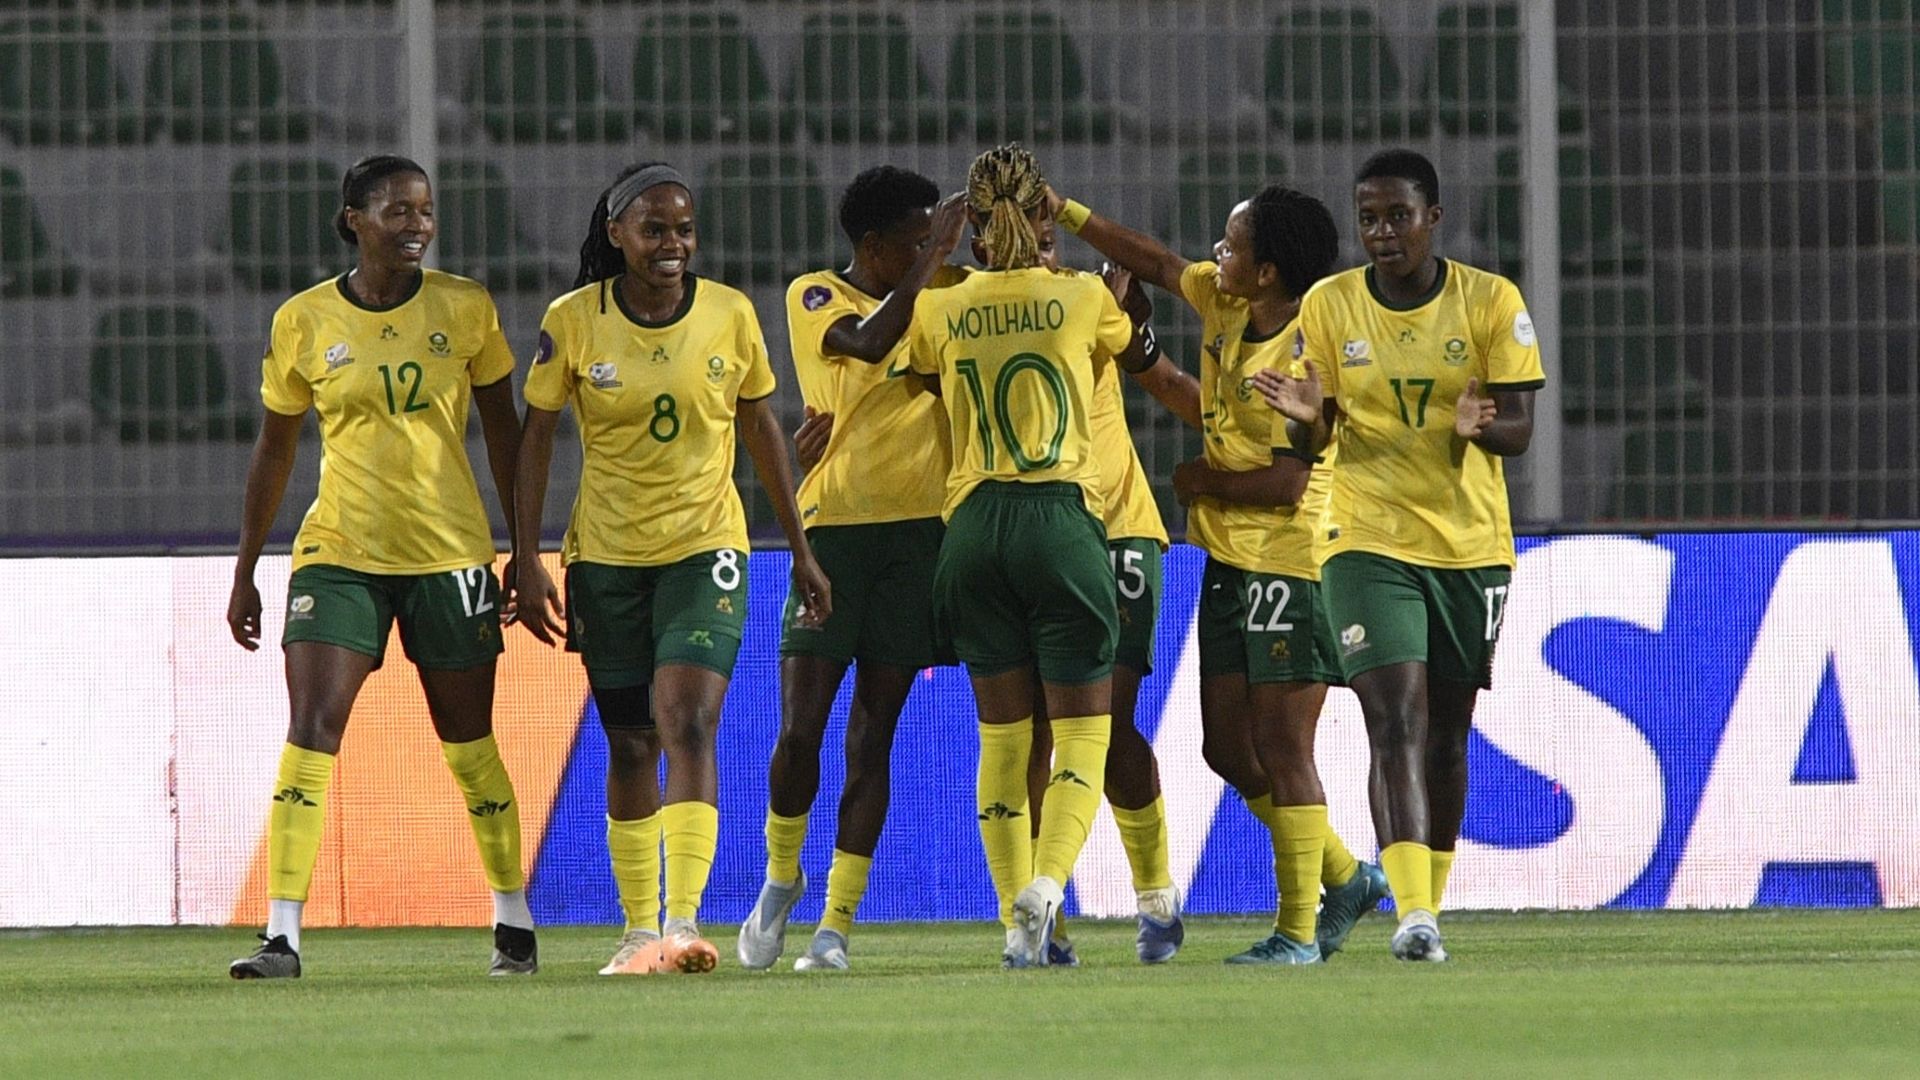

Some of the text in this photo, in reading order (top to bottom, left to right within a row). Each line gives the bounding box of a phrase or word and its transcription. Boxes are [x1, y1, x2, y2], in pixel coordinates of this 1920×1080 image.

[946, 299, 1064, 341] MOTLHALO
[378, 361, 430, 415] 12
[955, 352, 1068, 472] 10
[1389, 378, 1435, 428] 17
[650, 393, 680, 443] 8
[451, 565, 494, 618] 12
[712, 549, 740, 591] 8
[1247, 580, 1294, 632] 22
[1484, 585, 1508, 641] 17
